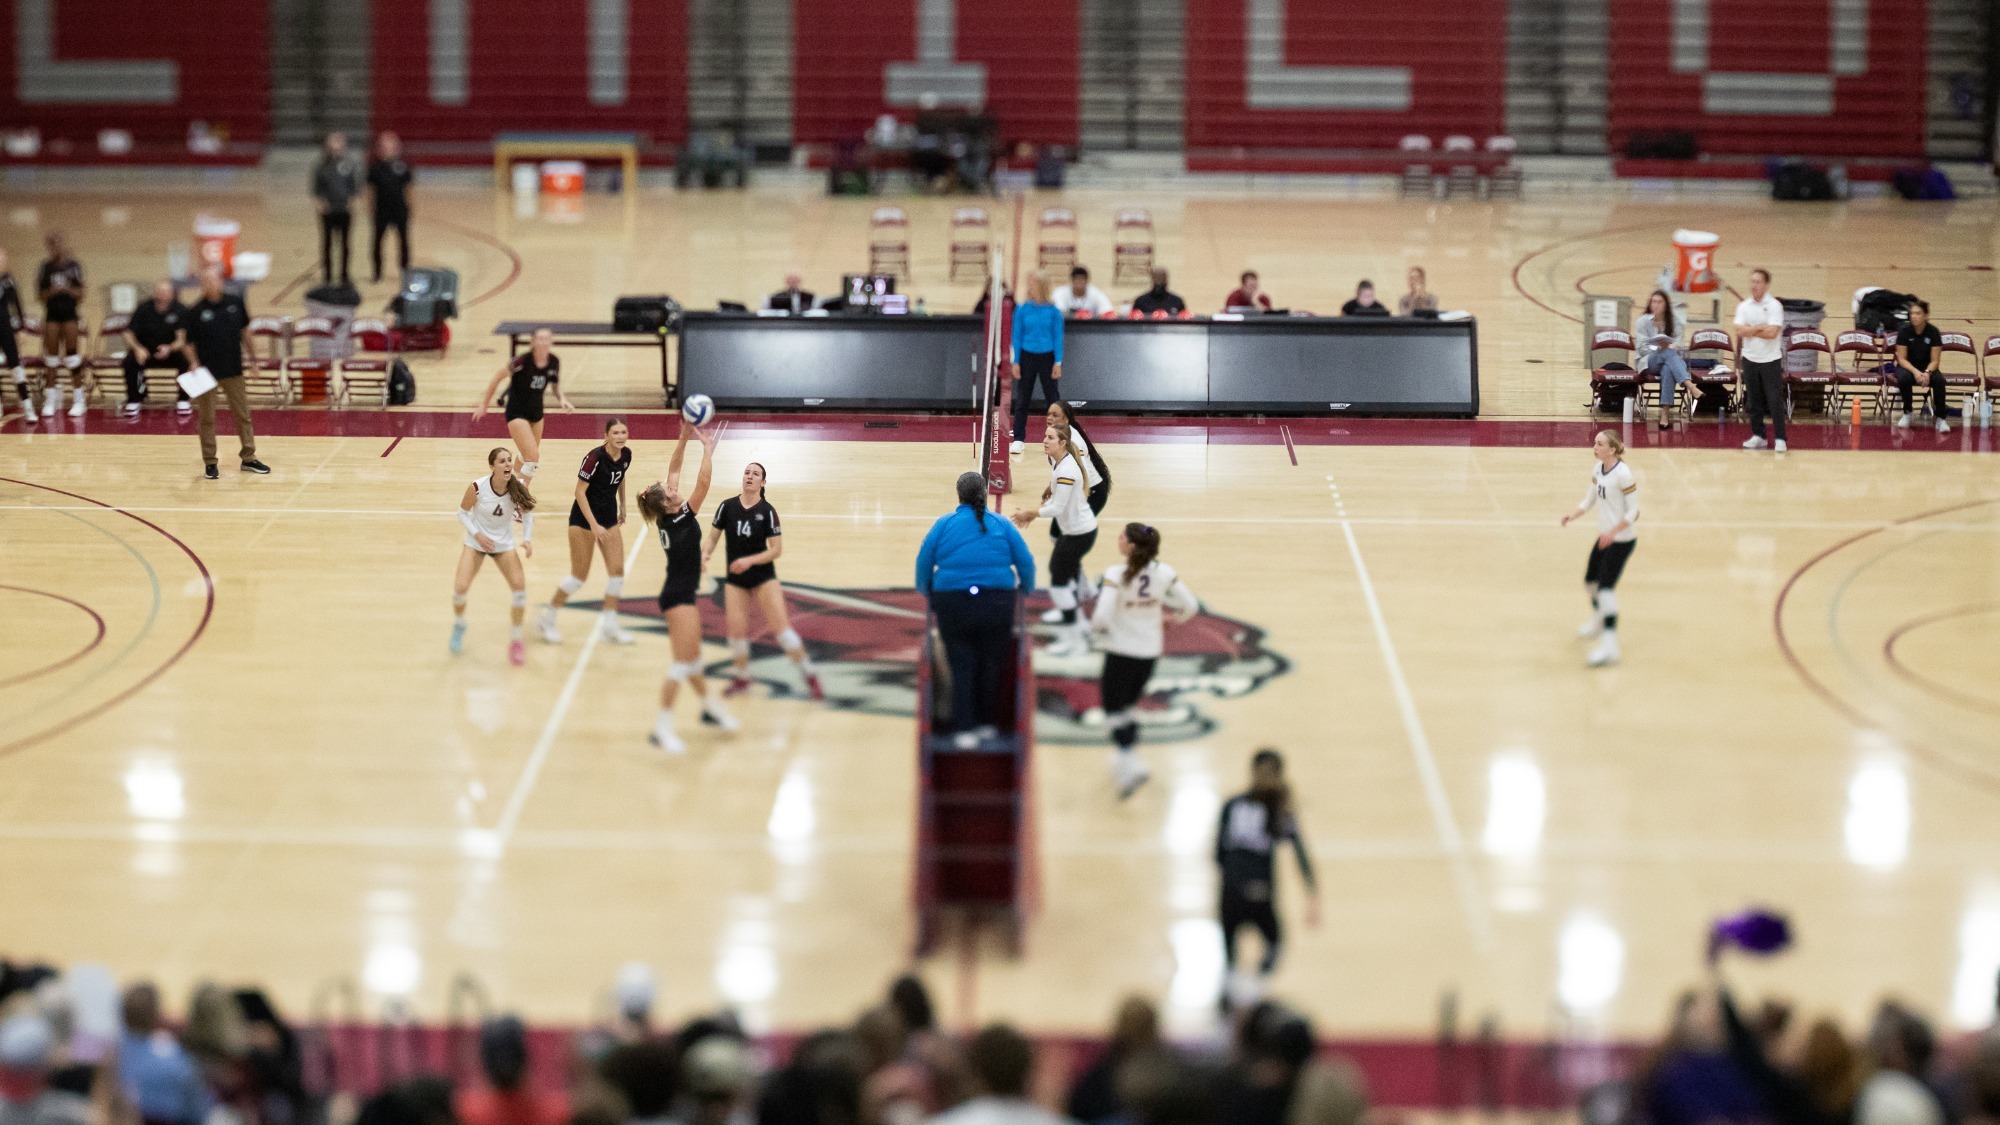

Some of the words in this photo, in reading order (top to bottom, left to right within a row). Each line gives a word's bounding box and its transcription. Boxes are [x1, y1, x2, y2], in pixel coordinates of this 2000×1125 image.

[1689, 251, 1708, 270] G
[610, 471, 622, 485] 12
[492, 503, 504, 517] 4
[737, 520, 752, 537] 14
[1138, 574, 1151, 598] 2
